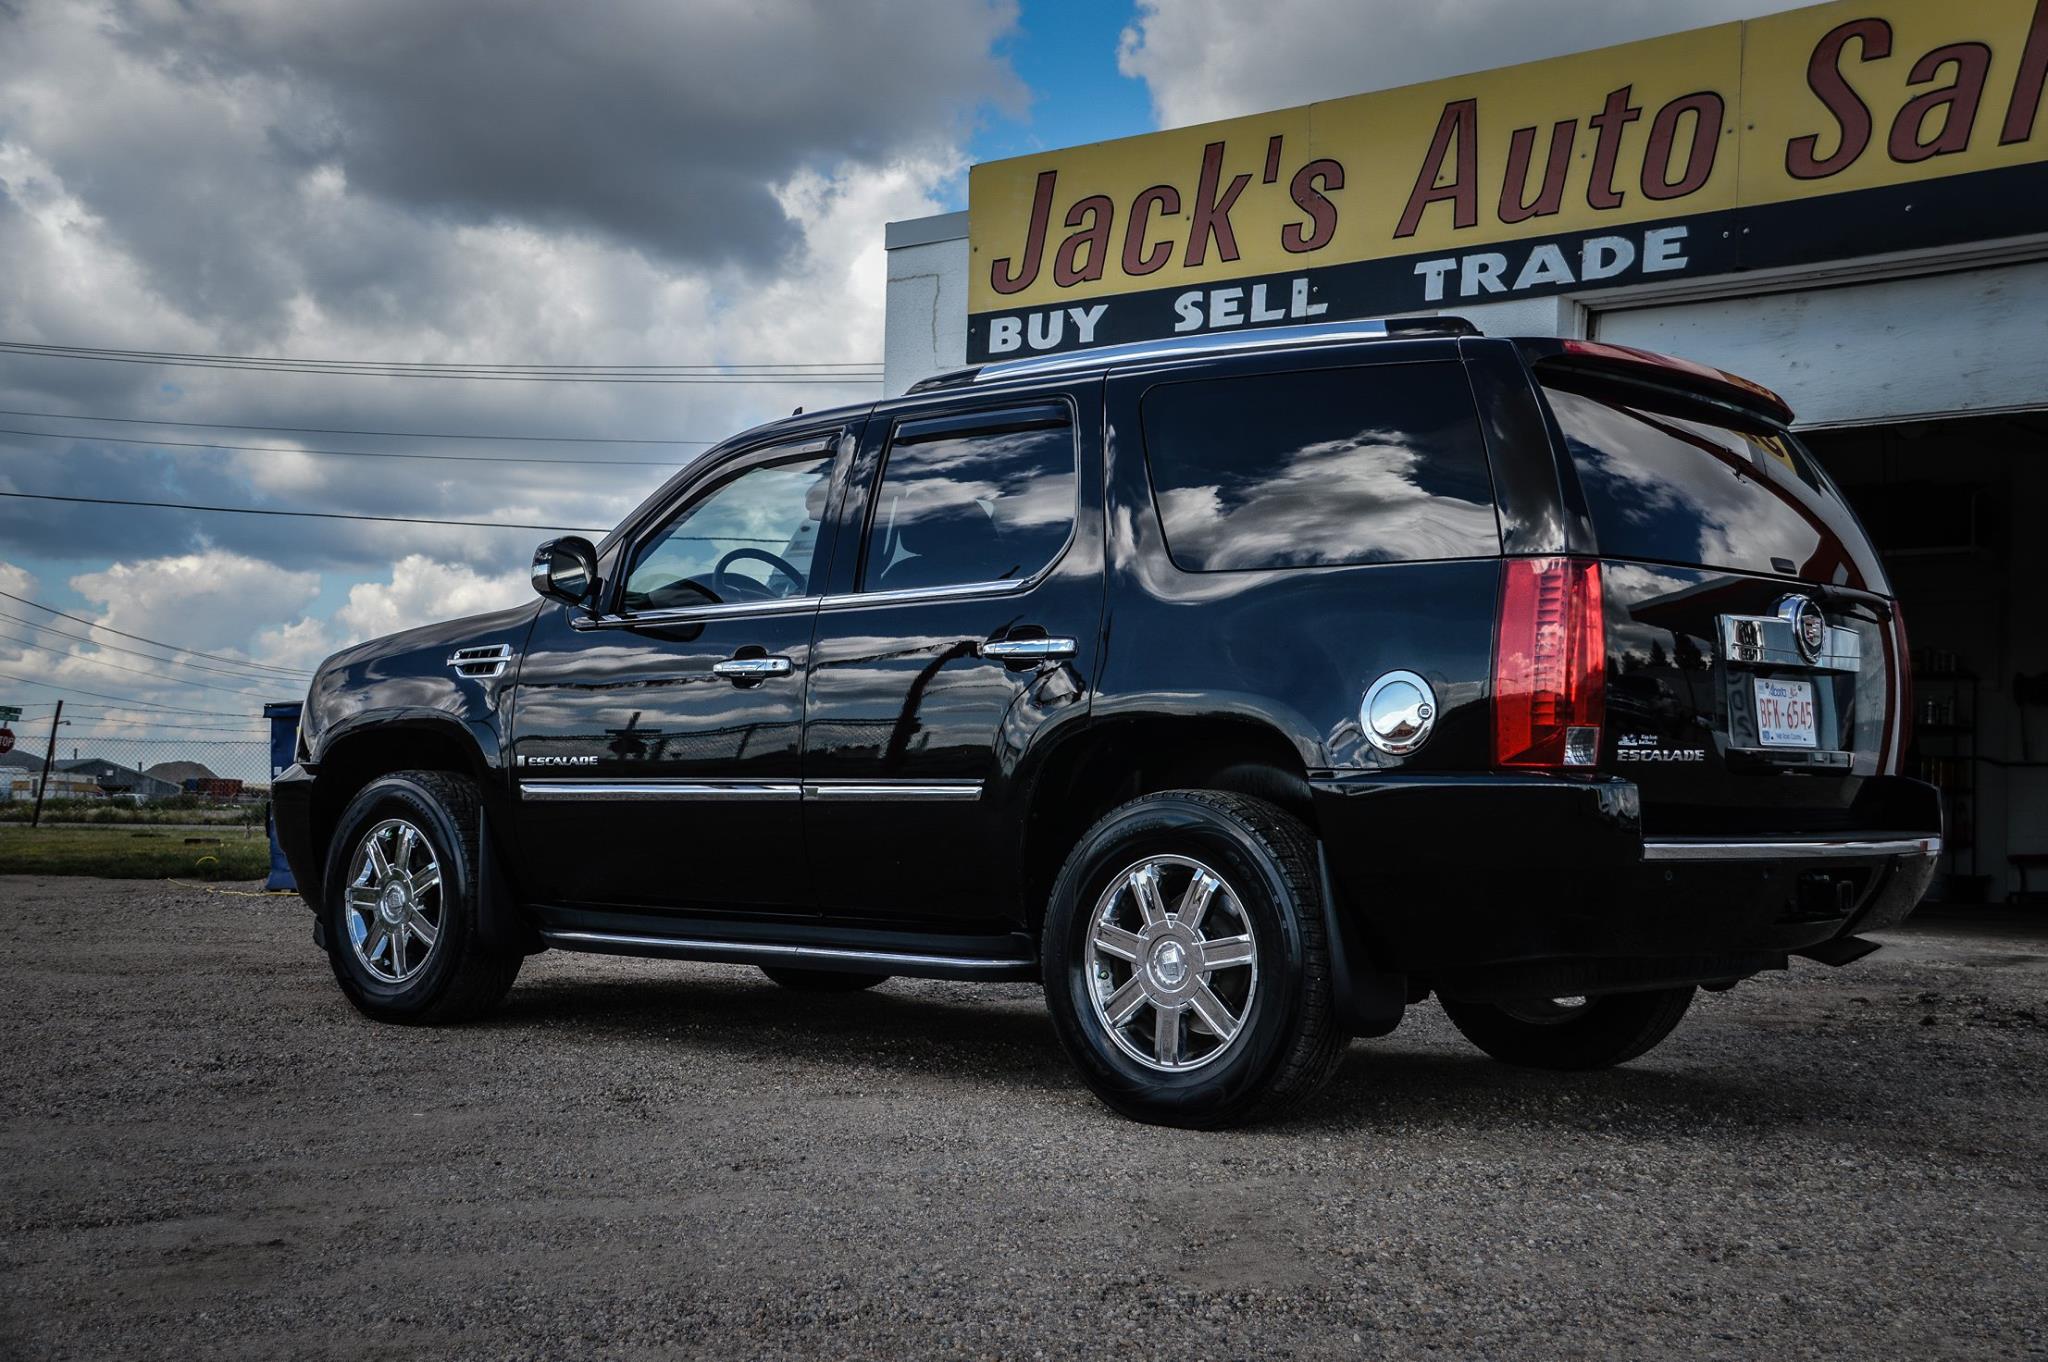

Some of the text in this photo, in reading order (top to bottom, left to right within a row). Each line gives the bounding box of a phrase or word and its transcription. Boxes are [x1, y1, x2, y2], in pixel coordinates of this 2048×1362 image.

[990, 135, 1345, 295] Jack's
[1392, 84, 1725, 240] Auto
[988, 225, 1690, 354] BUY SELL TRADE
[528, 755, 599, 766] ESCALADE
[1617, 749, 1704, 762] ESCALADE
